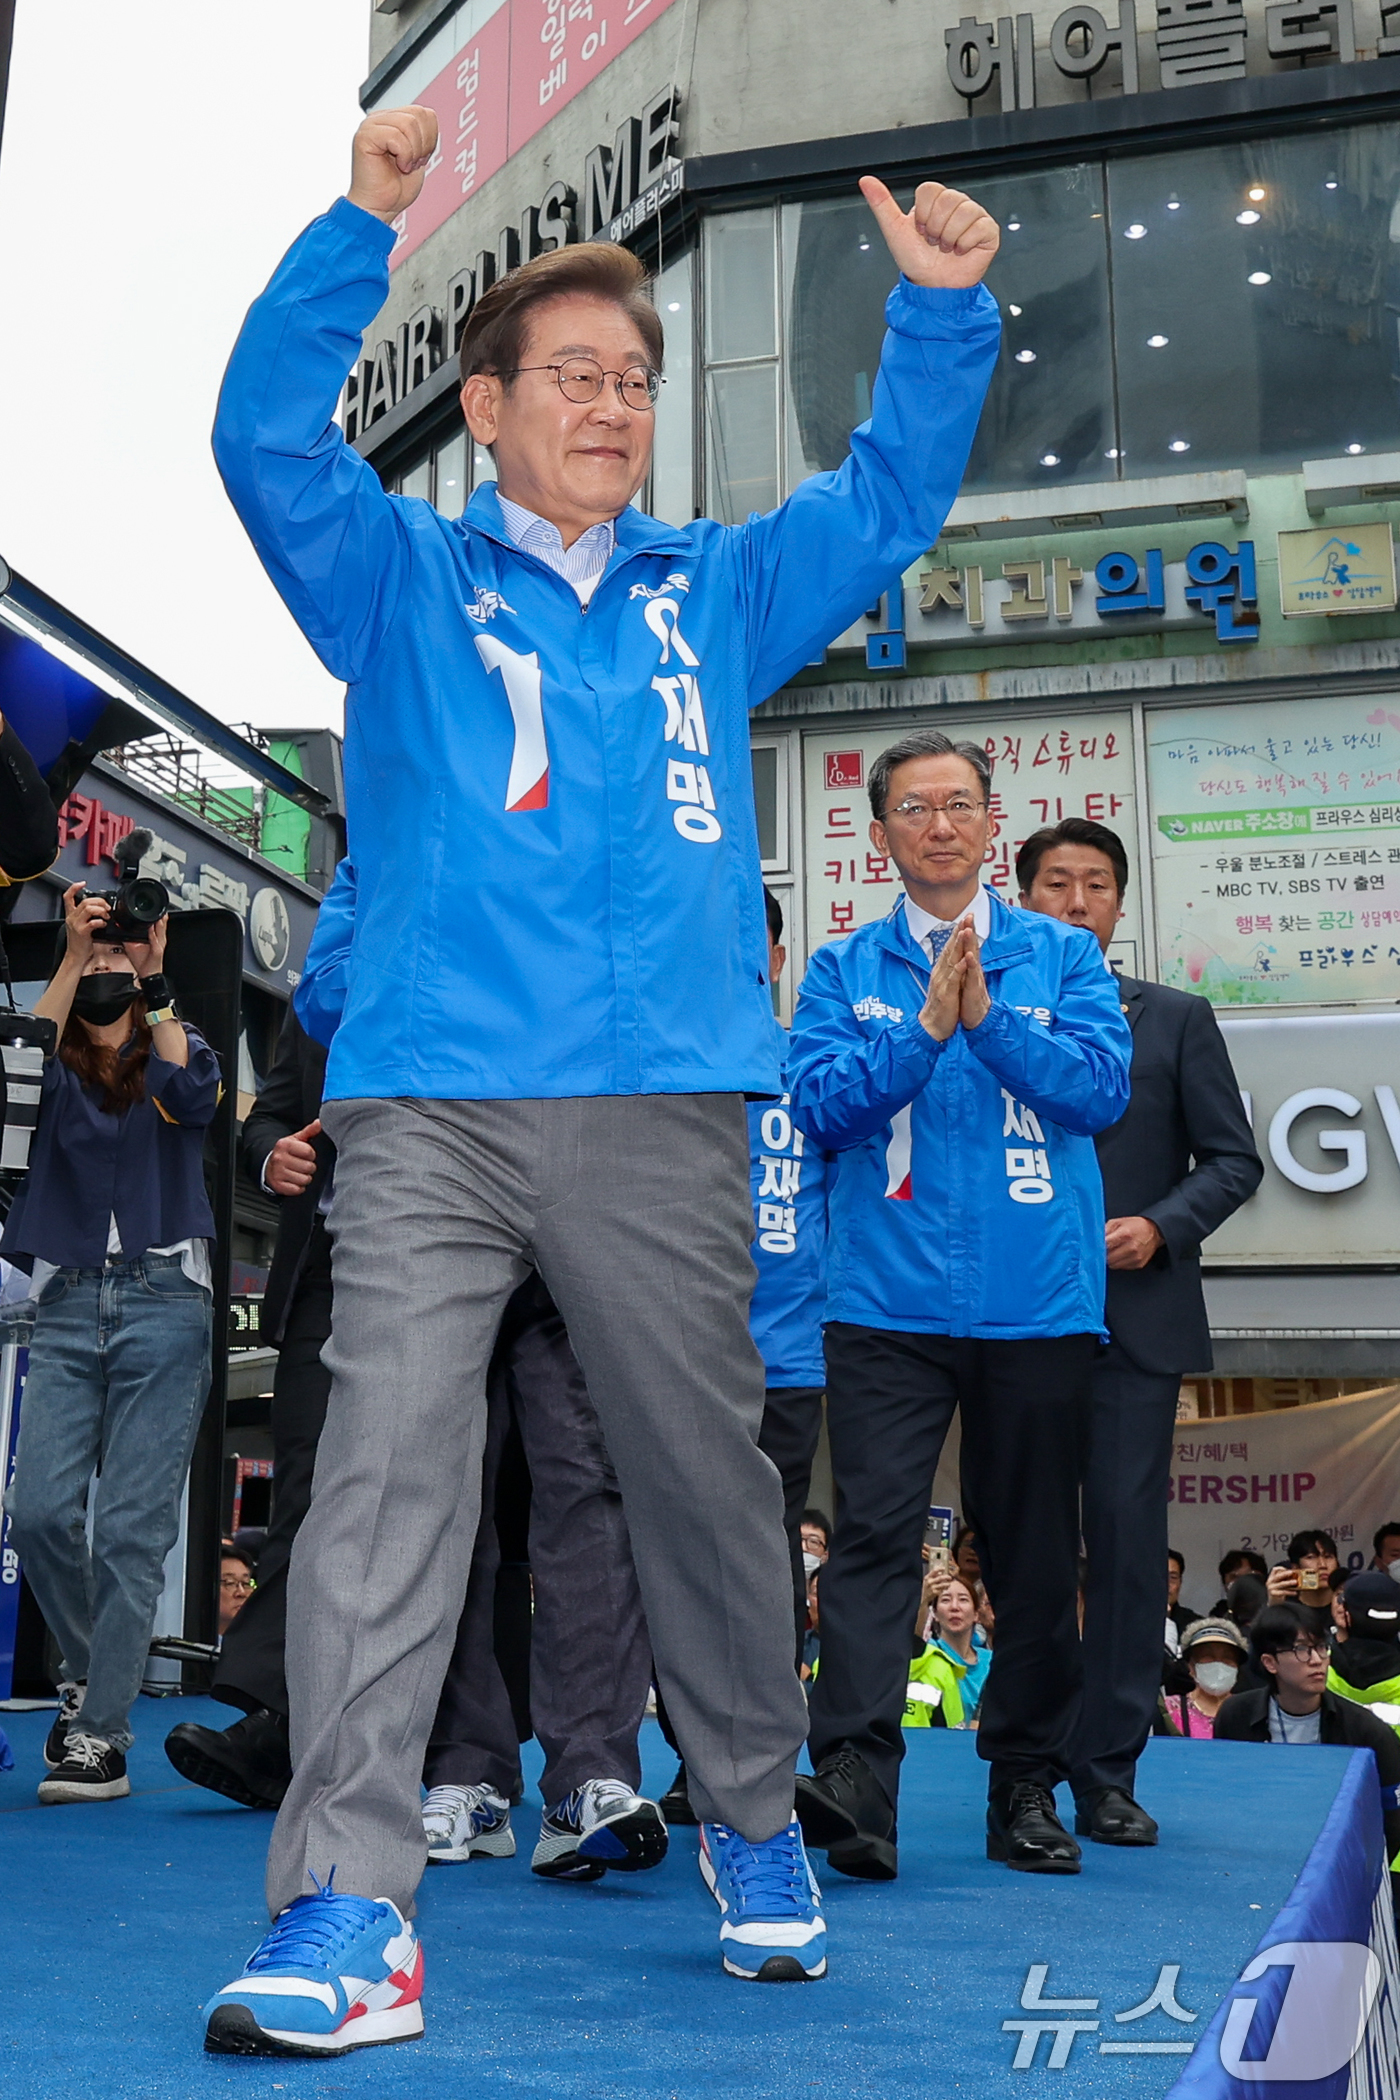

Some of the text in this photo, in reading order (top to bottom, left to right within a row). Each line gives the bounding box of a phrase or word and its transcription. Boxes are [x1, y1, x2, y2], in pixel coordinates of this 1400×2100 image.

[610, 166, 684, 242] 헤어플러스미
[342, 303, 438, 444] HAIR
[585, 82, 677, 242] ME
[1031, 730, 1120, 775] 스튜디오
[1168, 744, 1199, 764] 마음
[1207, 744, 1256, 758] 아파서
[1304, 736, 1335, 756] 있는
[1199, 780, 1248, 796] 당신도
[1360, 768, 1400, 790] 있어
[1191, 819, 1244, 834] NAVER
[1316, 809, 1366, 827] 프라우스
[824, 852, 902, 885] 키보
[1215, 856, 1243, 873] 우울
[1249, 854, 1305, 871] 분노조절
[1323, 850, 1382, 866] 스트레스
[1217, 883, 1252, 898] MBC
[1288, 879, 1320, 894] SBS
[1326, 878, 1347, 891] TV
[1354, 874, 1385, 892] 출연
[1235, 914, 1273, 935] 행복
[1278, 915, 1312, 932] 찾는
[1317, 910, 1354, 930] 공간
[853, 1003, 904, 1023] 민주당
[758, 1108, 805, 1254] 이재명
